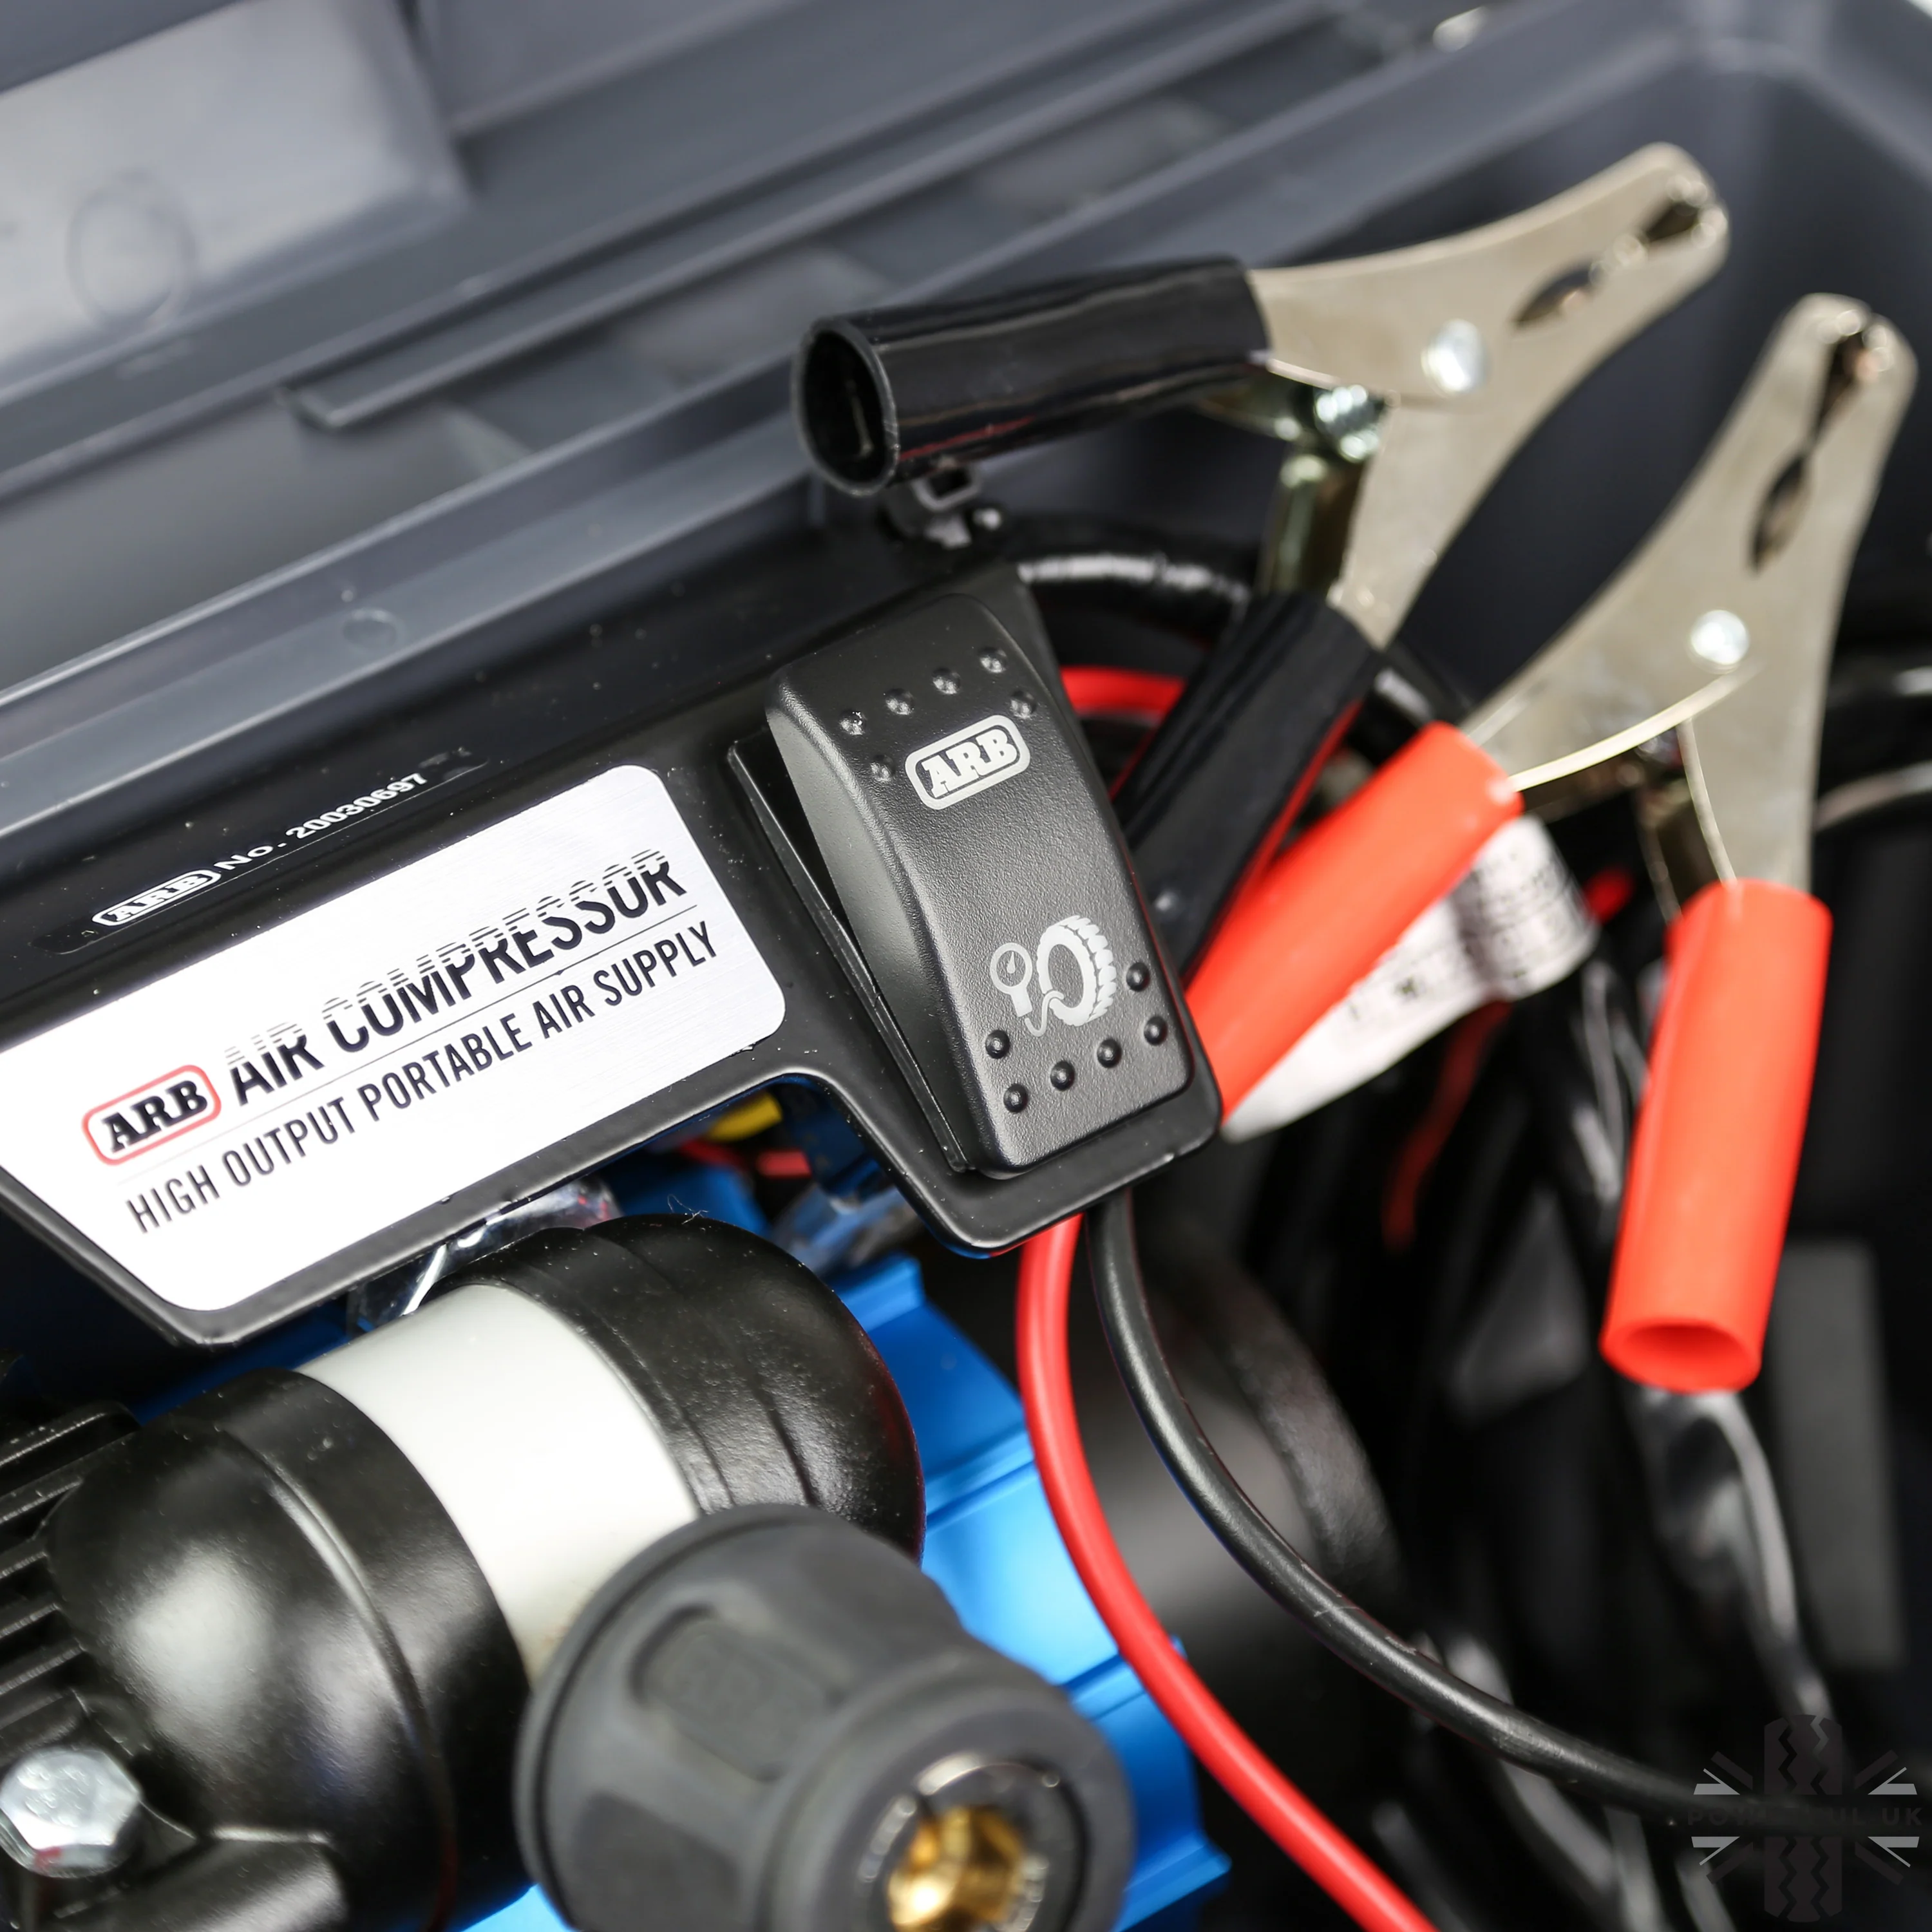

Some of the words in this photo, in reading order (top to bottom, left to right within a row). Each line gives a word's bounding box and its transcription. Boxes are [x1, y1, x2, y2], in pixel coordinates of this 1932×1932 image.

[106, 875, 213, 922] ARB
[213, 842, 287, 871] No.
[285, 773, 428, 839] 20030697
[920, 728, 1018, 799] ARB
[100, 1079, 209, 1153] ARB
[223, 1021, 324, 1106] AIR
[322, 849, 687, 1053] COMPRESSOR
[126, 1164, 219, 1234] HIGH
[221, 1096, 355, 1188] OUTPUT
[356, 1012, 533, 1122] PORTABLE
[532, 984, 596, 1039] AIR
[592, 920, 717, 1007] SUPPLY
